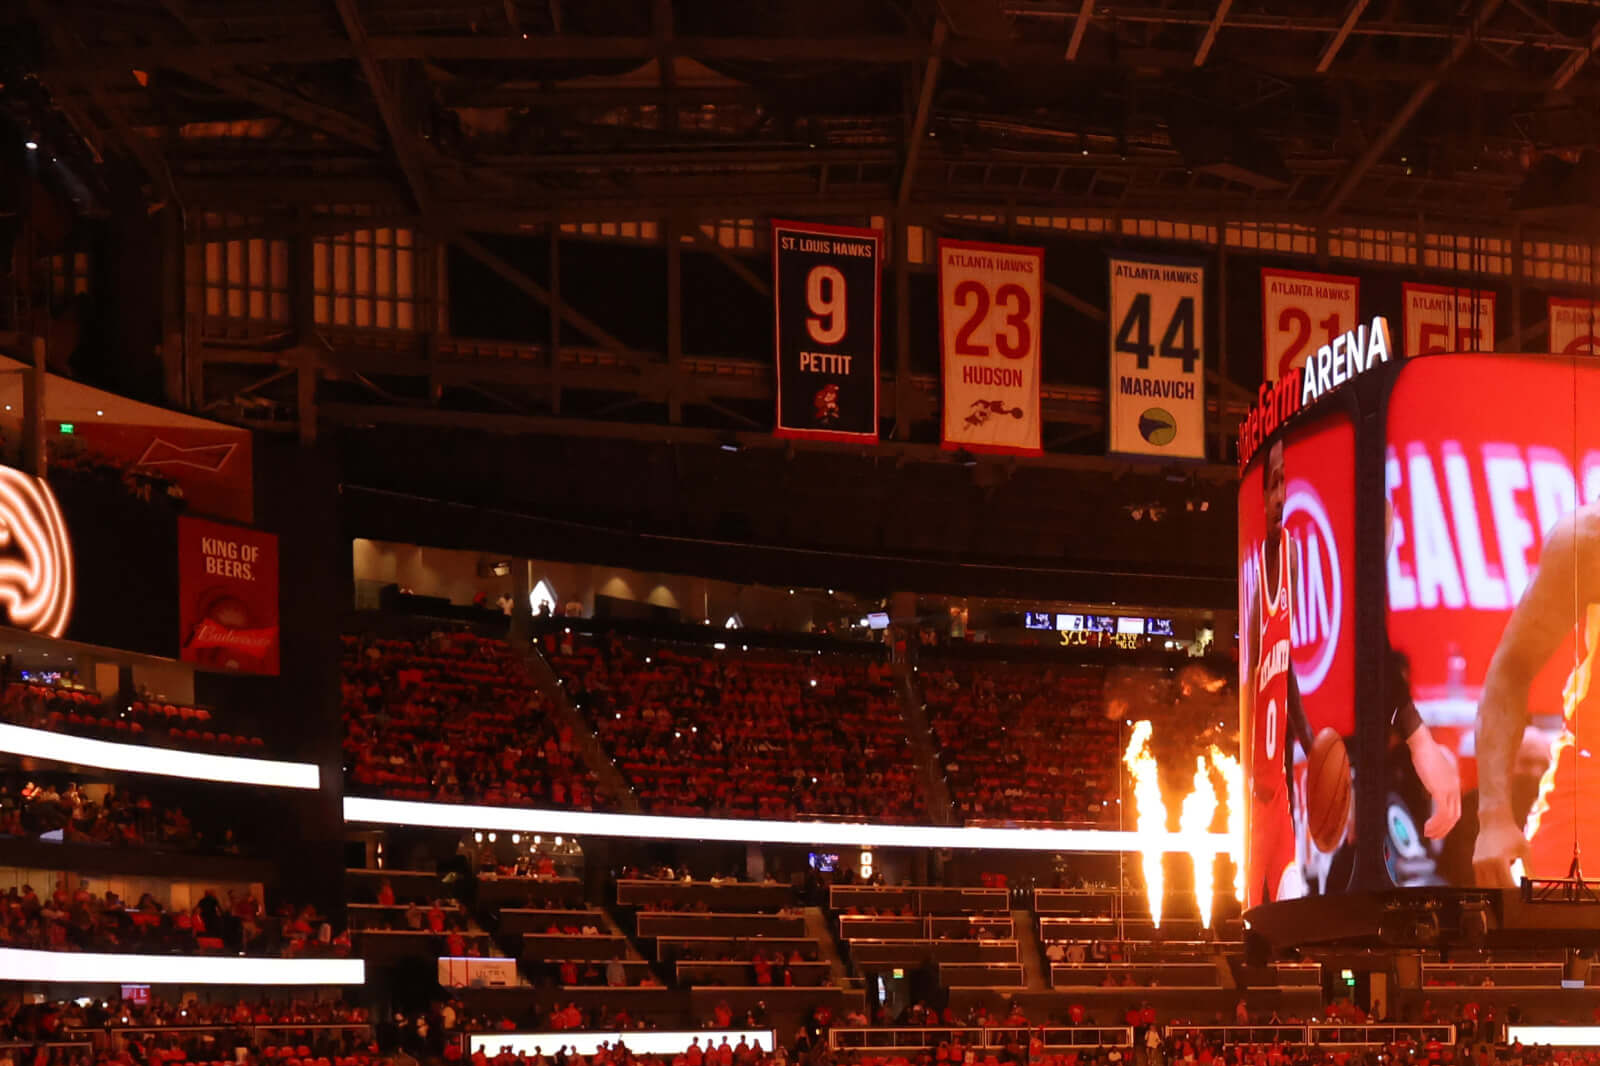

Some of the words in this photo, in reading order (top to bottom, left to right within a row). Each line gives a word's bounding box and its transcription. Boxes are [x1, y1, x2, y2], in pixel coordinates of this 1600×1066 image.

[781, 237, 798, 252] ST.
[799, 238, 831, 255] LOUIS
[832, 241, 873, 258] HAWKS
[947, 254, 994, 271] ATLANTA
[995, 258, 1034, 274] HAWKS
[1115, 265, 1161, 283] ATLANTA
[1162, 268, 1199, 285] HAWKS
[1270, 281, 1314, 298] ATLANTA
[1315, 286, 1351, 302] HAWKS
[805, 264, 847, 345] 9
[953, 279, 1032, 361] 23
[1114, 292, 1200, 373] 44
[799, 351, 853, 376] PETTIT
[962, 365, 1023, 388] HUDSON
[1120, 376, 1195, 400] MARAVICH
[1259, 367, 1300, 445] Farm
[1301, 316, 1389, 406] ARENA
[202, 536, 238, 560] KING
[240, 544, 260, 562] OF
[205, 557, 256, 581] BEERS.
[1265, 698, 1277, 760] 0
